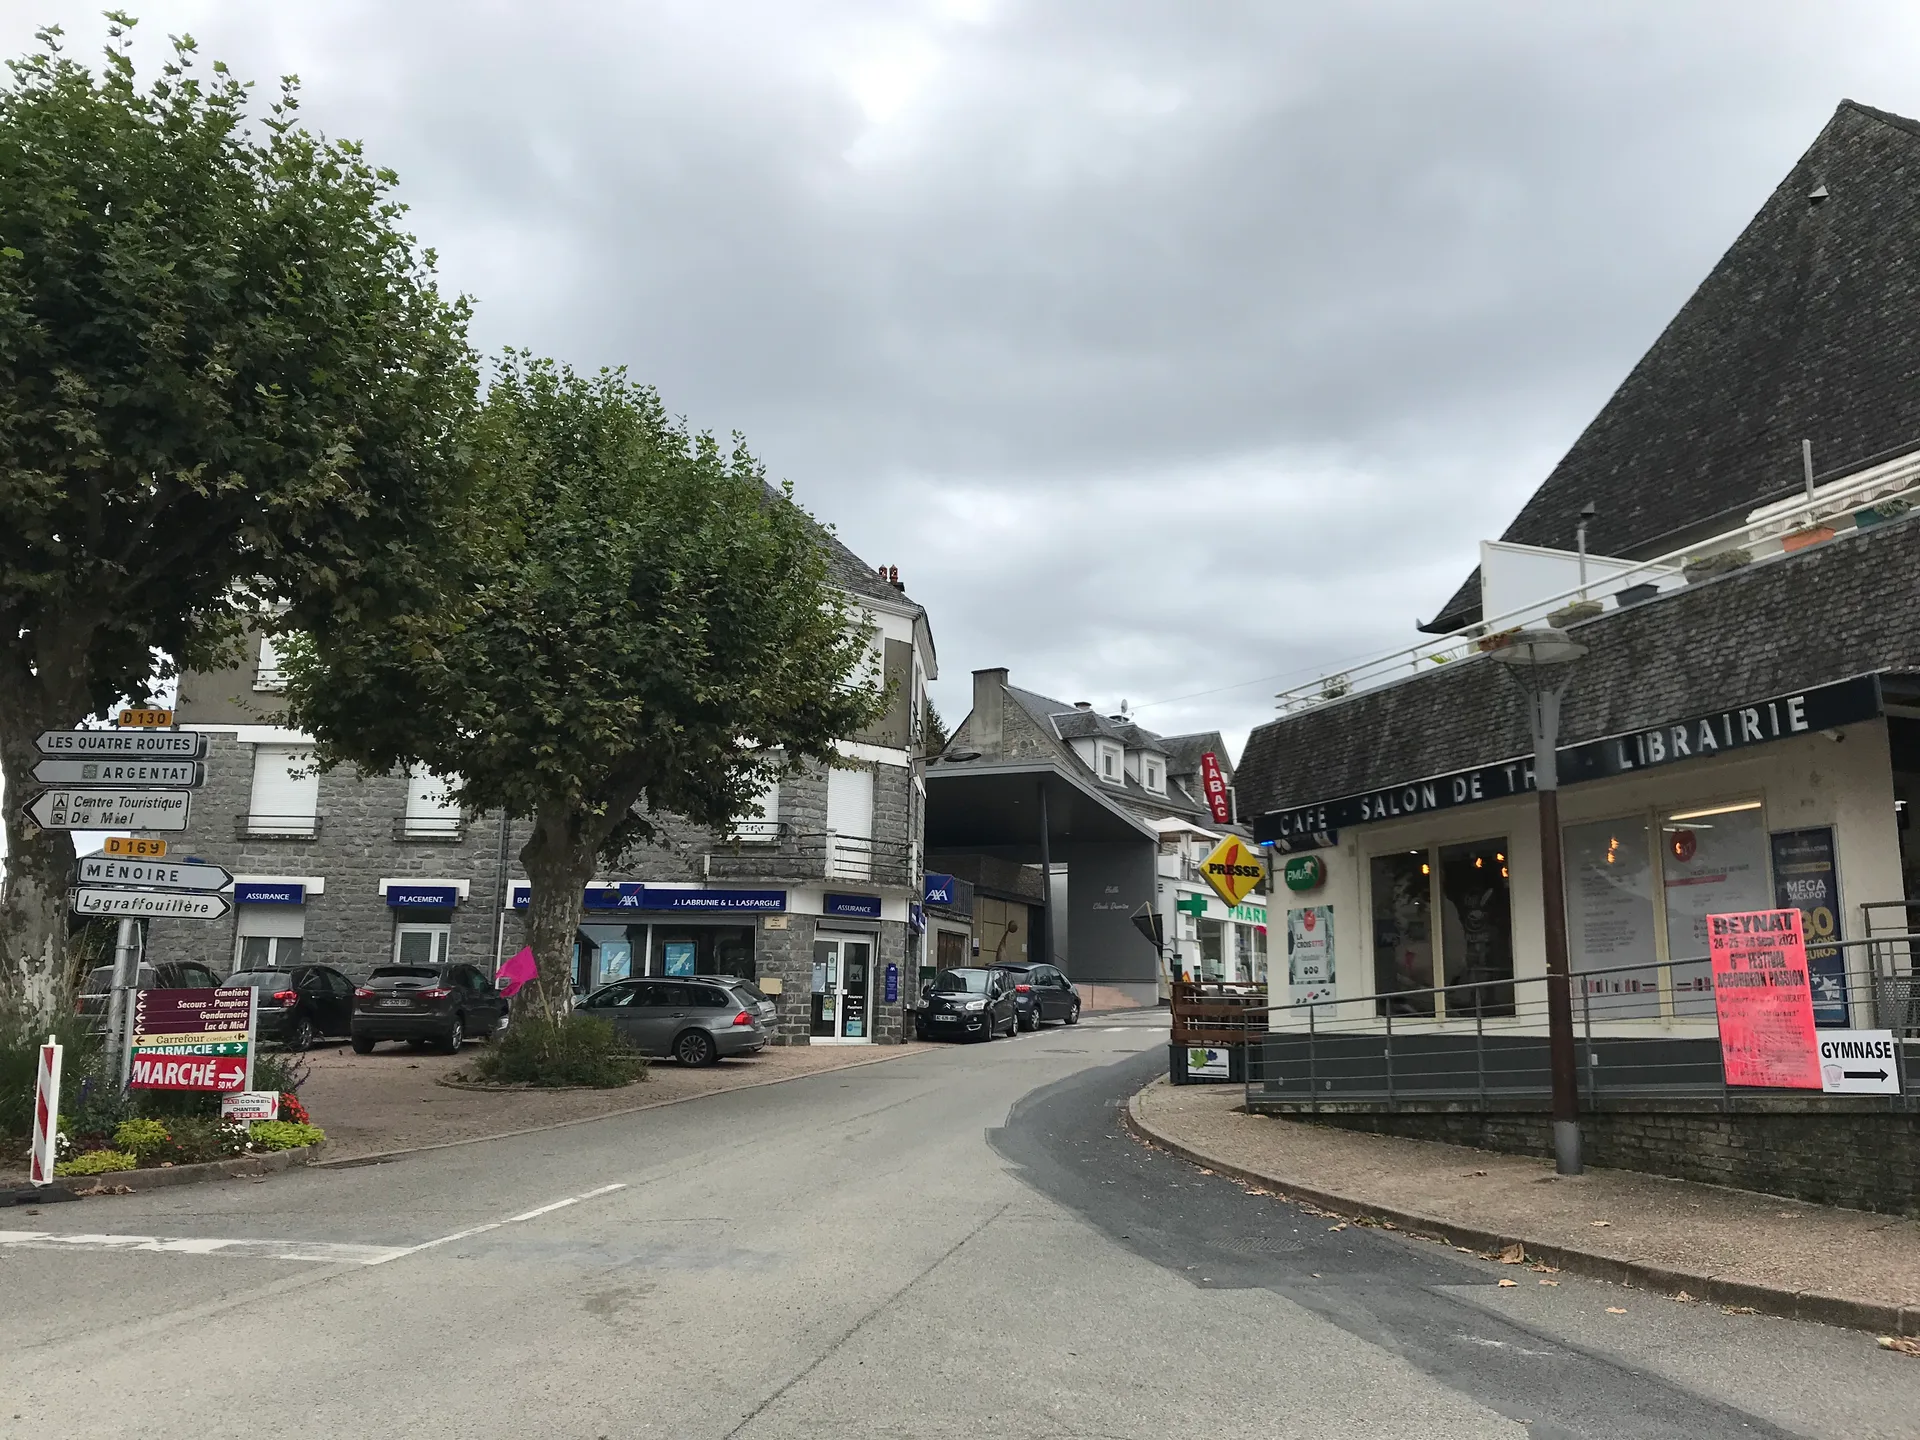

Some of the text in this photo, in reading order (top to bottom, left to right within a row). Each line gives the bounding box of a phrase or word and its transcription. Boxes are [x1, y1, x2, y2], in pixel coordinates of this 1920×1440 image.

[124, 712, 166, 724] D 130
[1616, 695, 1809, 770] LIBRAIRIE
[48, 737, 190, 750] LES QUATRE ROUTES
[102, 767, 188, 780] ARGENTAT
[1205, 756, 1226, 817] TABAC
[1360, 782, 1437, 821] SALON
[1452, 772, 1484, 801] DE
[74, 796, 182, 811] Centre Touristique
[70, 812, 134, 824] De Miel
[110, 840, 160, 854] D 169
[87, 863, 179, 882] MÉNOIRE
[1208, 863, 1260, 878] PRESSE
[1287, 869, 1305, 881] PMU
[1786, 879, 1827, 892] MEGA
[245, 892, 290, 901] ASSURANCE
[398, 895, 444, 903] PLACEMENT
[618, 895, 639, 906] AXA
[925, 889, 948, 901] AXA
[1788, 890, 1827, 901] JACKPOT
[83, 895, 209, 913] Lagraffouillère
[837, 904, 872, 913] ASSURANCE
[1712, 911, 1794, 936] BEYNAT
[1778, 933, 1799, 947] 2021
[1768, 969, 1806, 987] PASSION
[214, 988, 249, 997] Cimetière
[177, 1000, 207, 1009] Secours
[214, 999, 249, 1009] Pompiers
[199, 1010, 248, 1020] Gendarmerie
[204, 1020, 247, 1031] Lac de Miel
[156, 1033, 205, 1044] Carrefour
[138, 1044, 213, 1056] PHARMACIE
[1821, 1041, 1892, 1059] GYMNASE
[132, 1059, 216, 1087] MARCHÉ
[217, 1081, 225, 1089] 50
